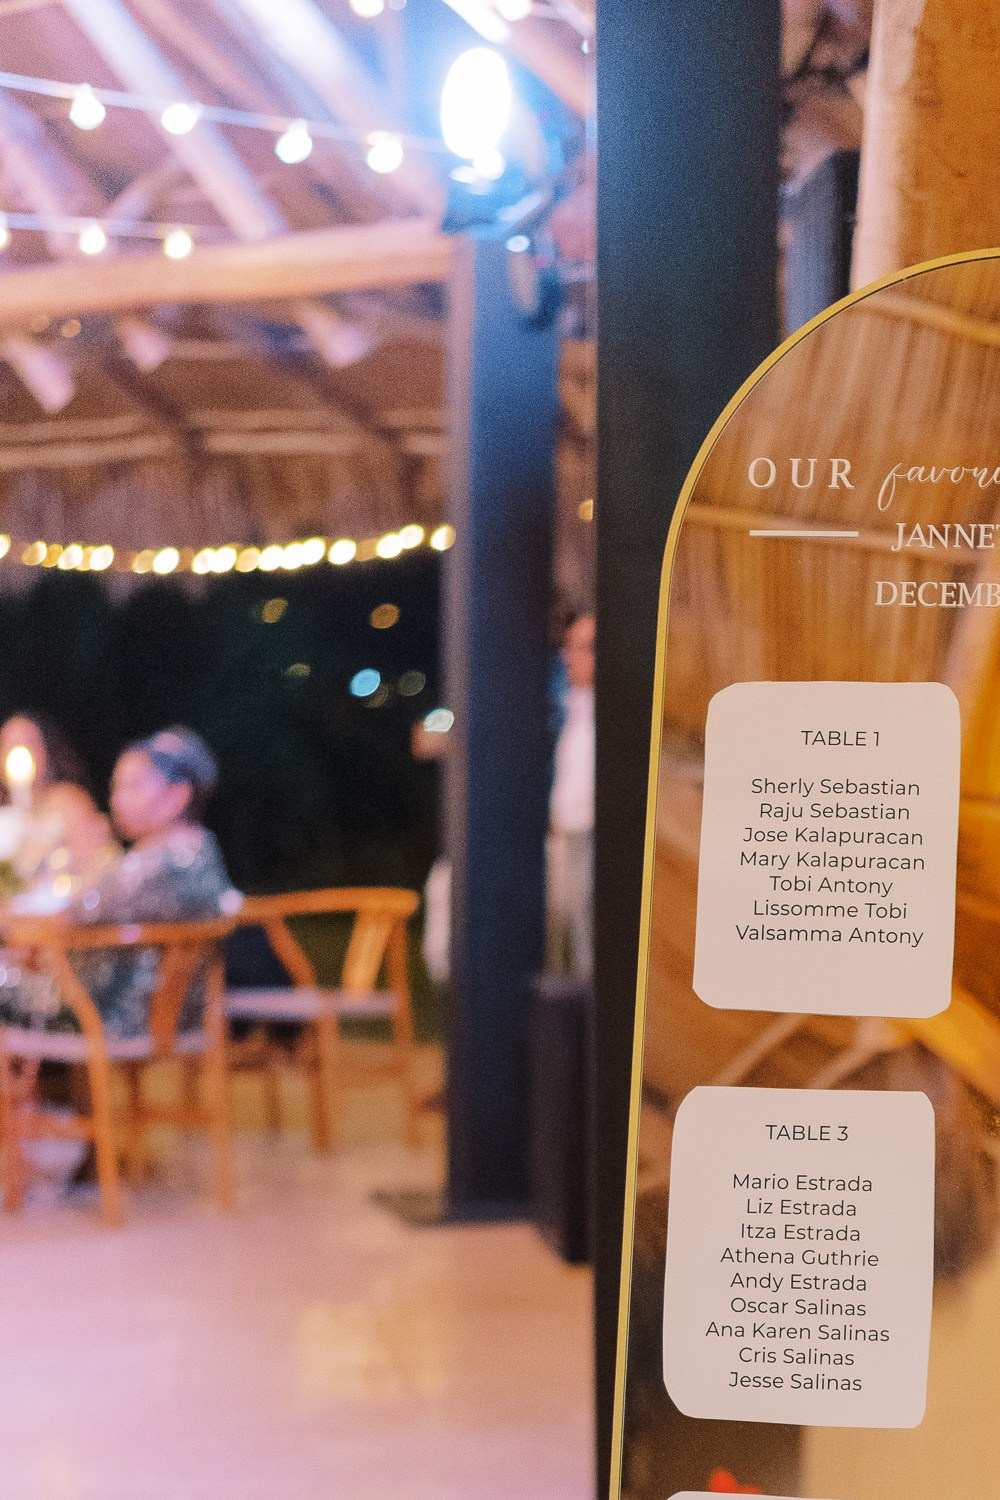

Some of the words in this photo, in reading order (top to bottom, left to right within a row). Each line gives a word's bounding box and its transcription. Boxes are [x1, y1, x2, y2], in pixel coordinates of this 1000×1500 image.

[748, 457, 854, 489] OUR
[800, 729, 868, 747] TABLE
[872, 730, 880, 748] 1
[750, 776, 815, 799] Sherly
[819, 777, 921, 797] Sebastian
[759, 801, 804, 823] Raju
[809, 801, 910, 821] Sebastian
[742, 826, 789, 843] Jose
[794, 825, 924, 848] Kalapuracan
[739, 850, 791, 872] Mary
[796, 850, 926, 873] Kalapuracan
[768, 874, 813, 893] Tobi
[816, 876, 894, 899] Antony
[753, 898, 860, 919] Lissomme
[863, 901, 908, 920] Tobi
[734, 923, 843, 943] Valsamma
[847, 926, 925, 949] Antony
[764, 1123, 832, 1142] TABLE
[836, 1125, 849, 1142] 3
[732, 1172, 790, 1191] Mario
[795, 1173, 873, 1193] Estrada
[746, 1196, 774, 1215] Liz
[779, 1198, 857, 1218] Estrada
[740, 1222, 777, 1240] Itza
[783, 1223, 861, 1243] Estrada
[719, 1246, 795, 1265] Athena
[800, 1248, 880, 1268] Guthrie
[729, 1271, 785, 1294] Andy
[790, 1273, 868, 1292] Estrada
[729, 1296, 790, 1315] Oscar
[794, 1298, 867, 1317] Salinas
[704, 1320, 746, 1339] Ana
[752, 1321, 812, 1341] Karen
[817, 1323, 891, 1343] Salinas
[738, 1345, 778, 1364] Cris
[782, 1347, 856, 1367] Salinas
[727, 1370, 785, 1390] Jesse
[789, 1372, 863, 1392] Salinas
